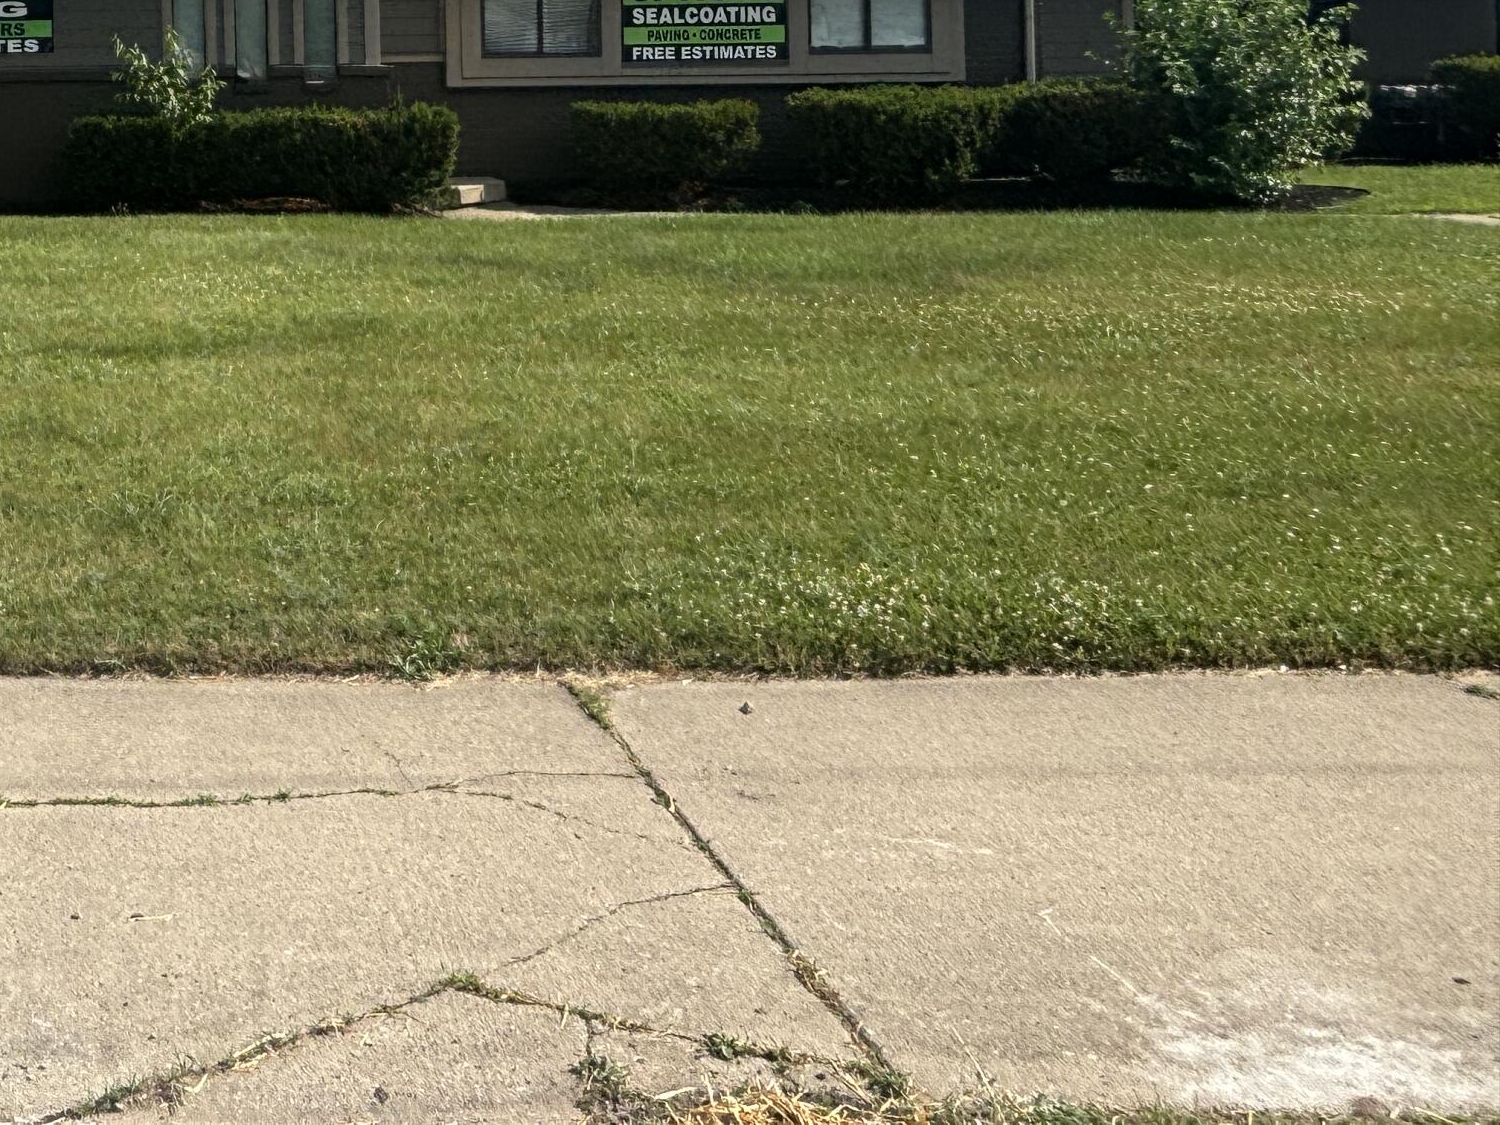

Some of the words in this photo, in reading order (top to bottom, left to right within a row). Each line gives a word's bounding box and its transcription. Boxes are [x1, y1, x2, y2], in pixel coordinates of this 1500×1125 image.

[632, 5, 776, 25] SEALCOATING
[647, 29, 690, 42] PAVING
[700, 28, 762, 41] CONCRETE
[632, 46, 676, 60] FREE
[681, 45, 777, 60] ESTIMATES
